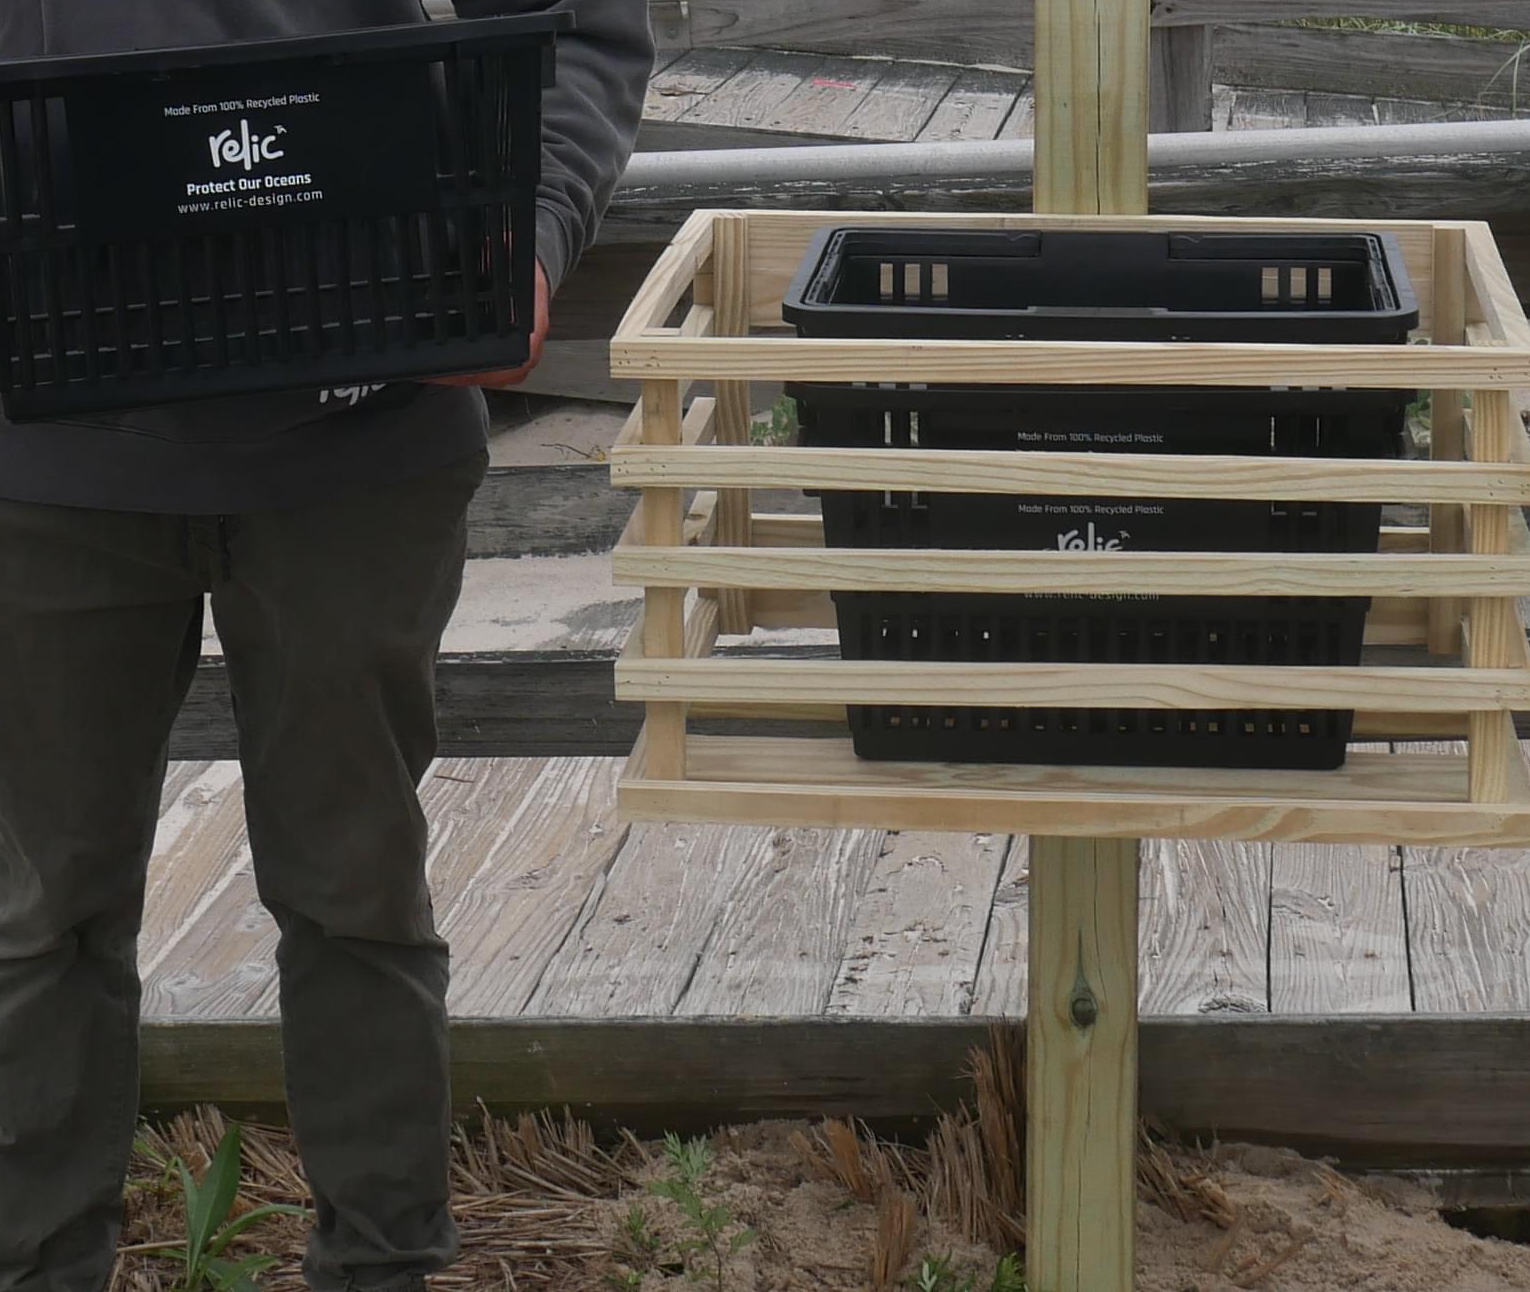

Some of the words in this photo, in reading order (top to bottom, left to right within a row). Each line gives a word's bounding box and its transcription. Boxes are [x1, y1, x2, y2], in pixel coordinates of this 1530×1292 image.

[165, 106, 190, 117] Made
[193, 104, 217, 113] From
[220, 101, 244, 111] 100%
[247, 95, 286, 109] Recycled
[289, 92, 320, 104] Plastic
[209, 119, 284, 170] relic
[187, 180, 236, 195] Protect
[239, 178, 261, 190] Our
[265, 173, 311, 188] Oceans
[178, 190, 323, 214] www.relic-design.com
